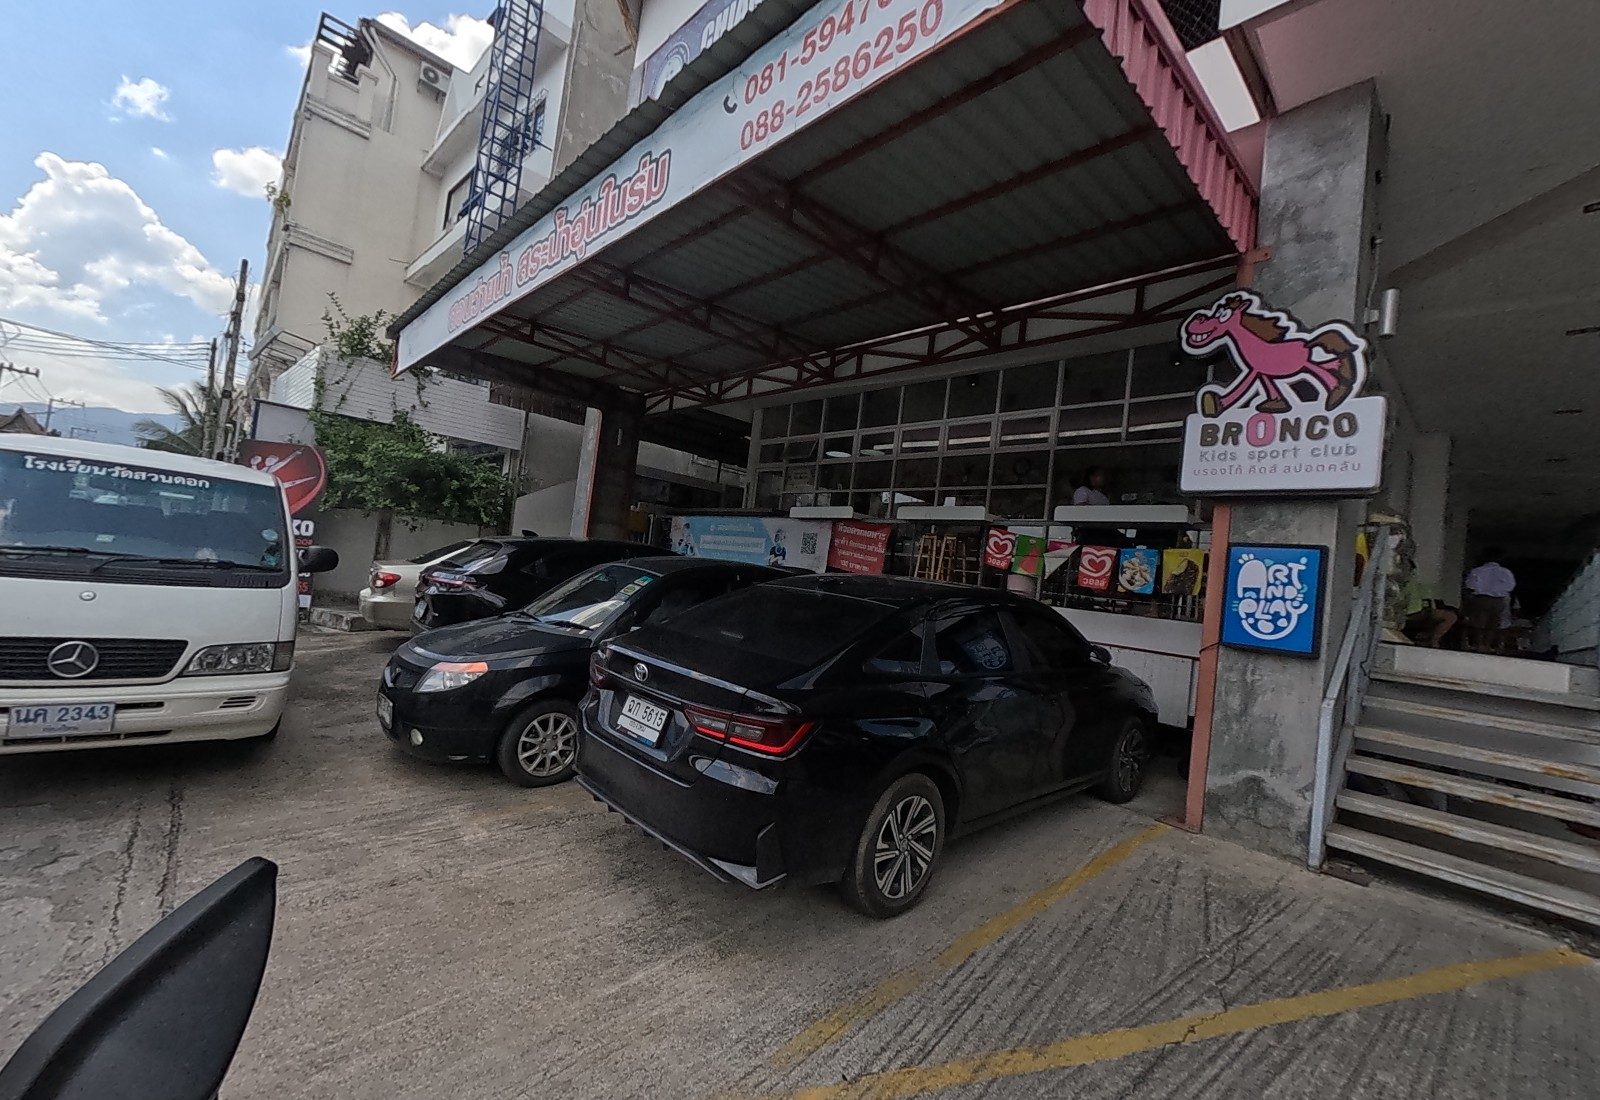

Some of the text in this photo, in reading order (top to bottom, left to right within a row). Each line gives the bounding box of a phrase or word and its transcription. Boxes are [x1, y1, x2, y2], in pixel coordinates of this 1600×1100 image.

[744, 0, 893, 105] 081-5947
[740, 0, 943, 151] 088-2586250
[516, 148, 671, 287] สระน้ำอุ่นในร่ม
[1200, 412, 1358, 447] BRONCO
[1199, 443, 1358, 463] Kids sport club
[23, 455, 210, 489] โรงเรียนวัดสวนดอก
[1237, 558, 1307, 599] ART
[56, 705, 110, 723] 2343
[642, 705, 666, 727] 5615
